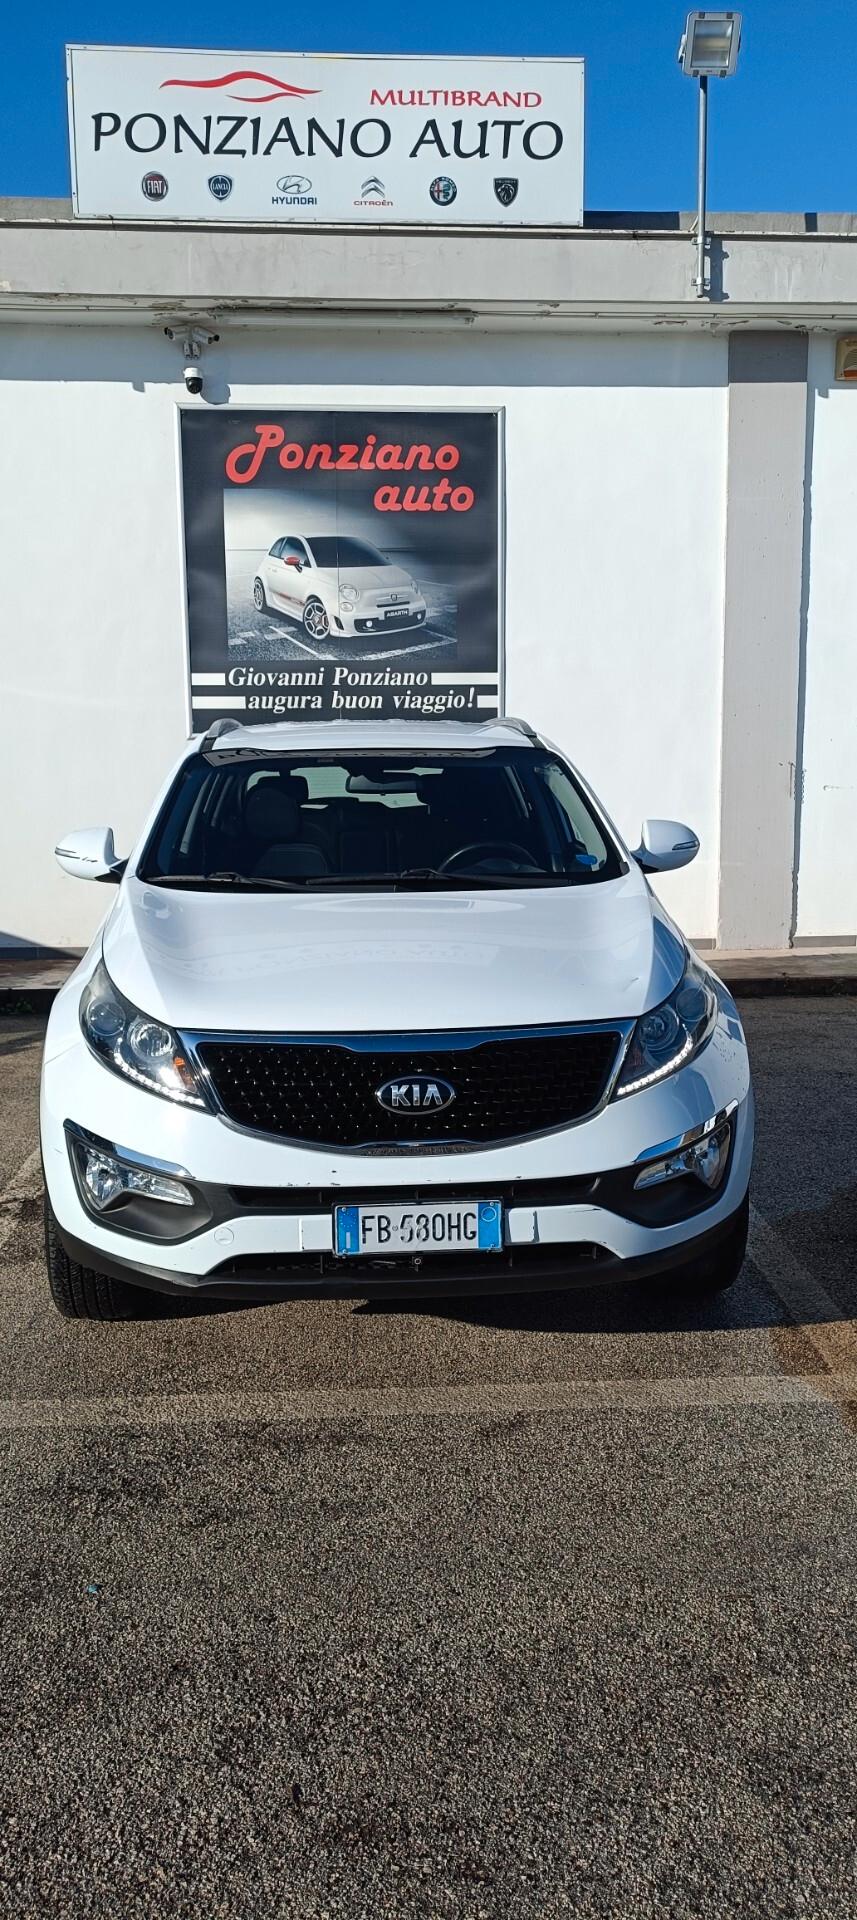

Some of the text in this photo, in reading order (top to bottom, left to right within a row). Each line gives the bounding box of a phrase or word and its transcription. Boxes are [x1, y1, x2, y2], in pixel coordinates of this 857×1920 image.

[369, 89, 542, 108] MULTIBRAND
[91, 112, 564, 160] PONZIANO AUTO
[147, 180, 163, 194] FIAT
[212, 183, 229, 191] LANCIA
[271, 196, 318, 205] HYUNDAI
[225, 424, 460, 484] Ponziano
[373, 478, 475, 512] auto
[228, 667, 429, 686] Giovanni Ponziano
[247, 687, 476, 714] augura buon viaggio!
[390, 1084, 443, 1107] KIA
[361, 1213, 392, 1244] FB
